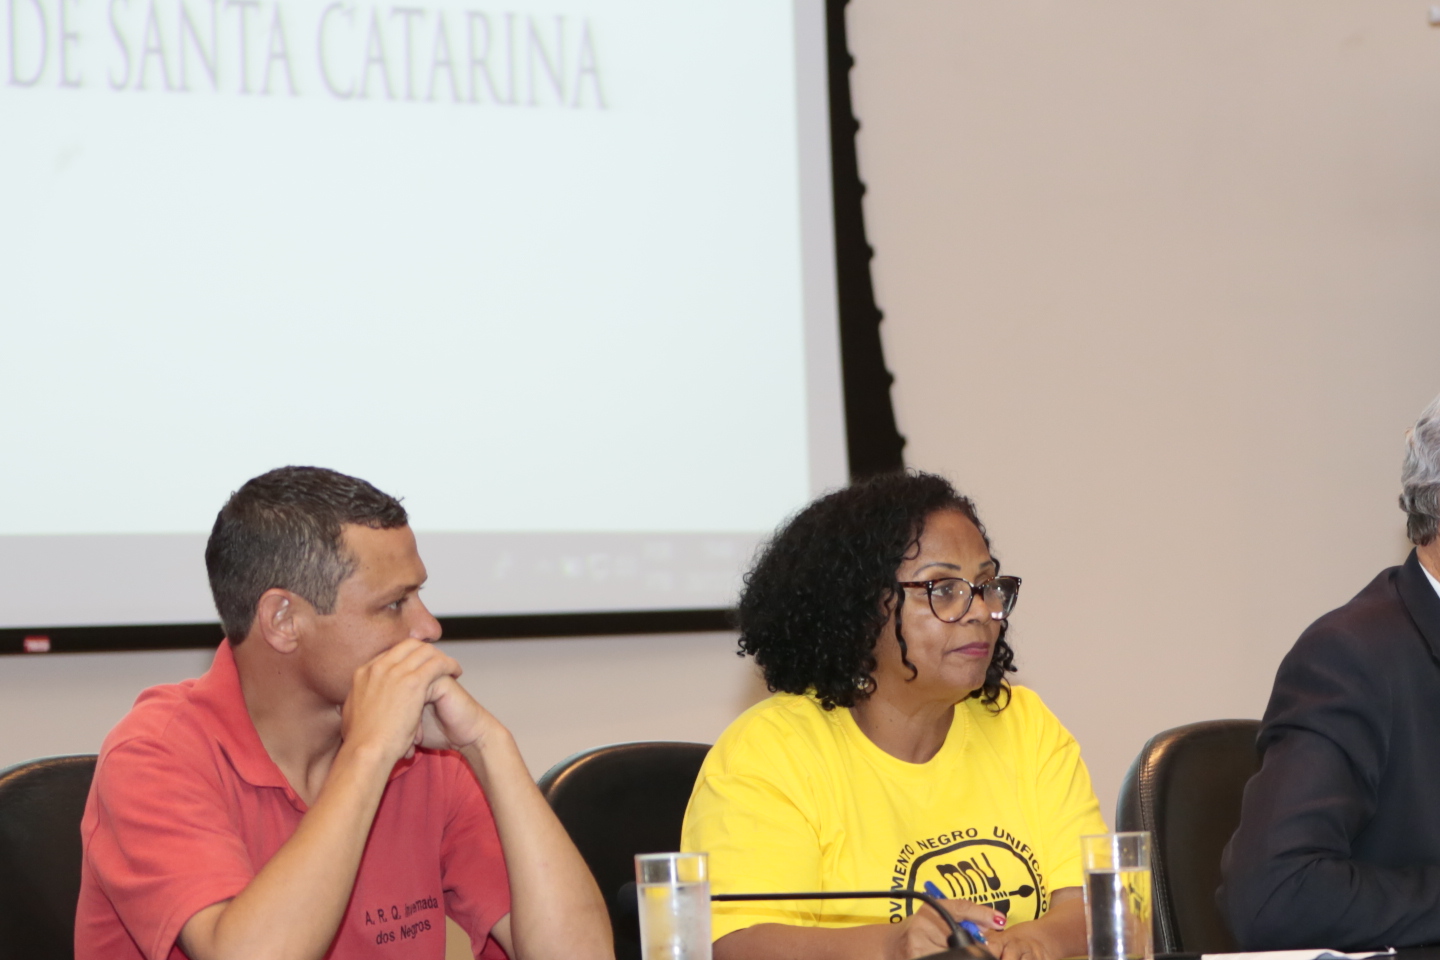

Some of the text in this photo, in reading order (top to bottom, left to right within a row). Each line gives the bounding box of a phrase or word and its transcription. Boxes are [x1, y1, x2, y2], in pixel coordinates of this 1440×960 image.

[6, 0, 610, 110] DE SANTA CATARINA
[889, 826, 1048, 923] OVMENTO NEGRO UNIFICADO
[376, 919, 432, 945] dos Negros
